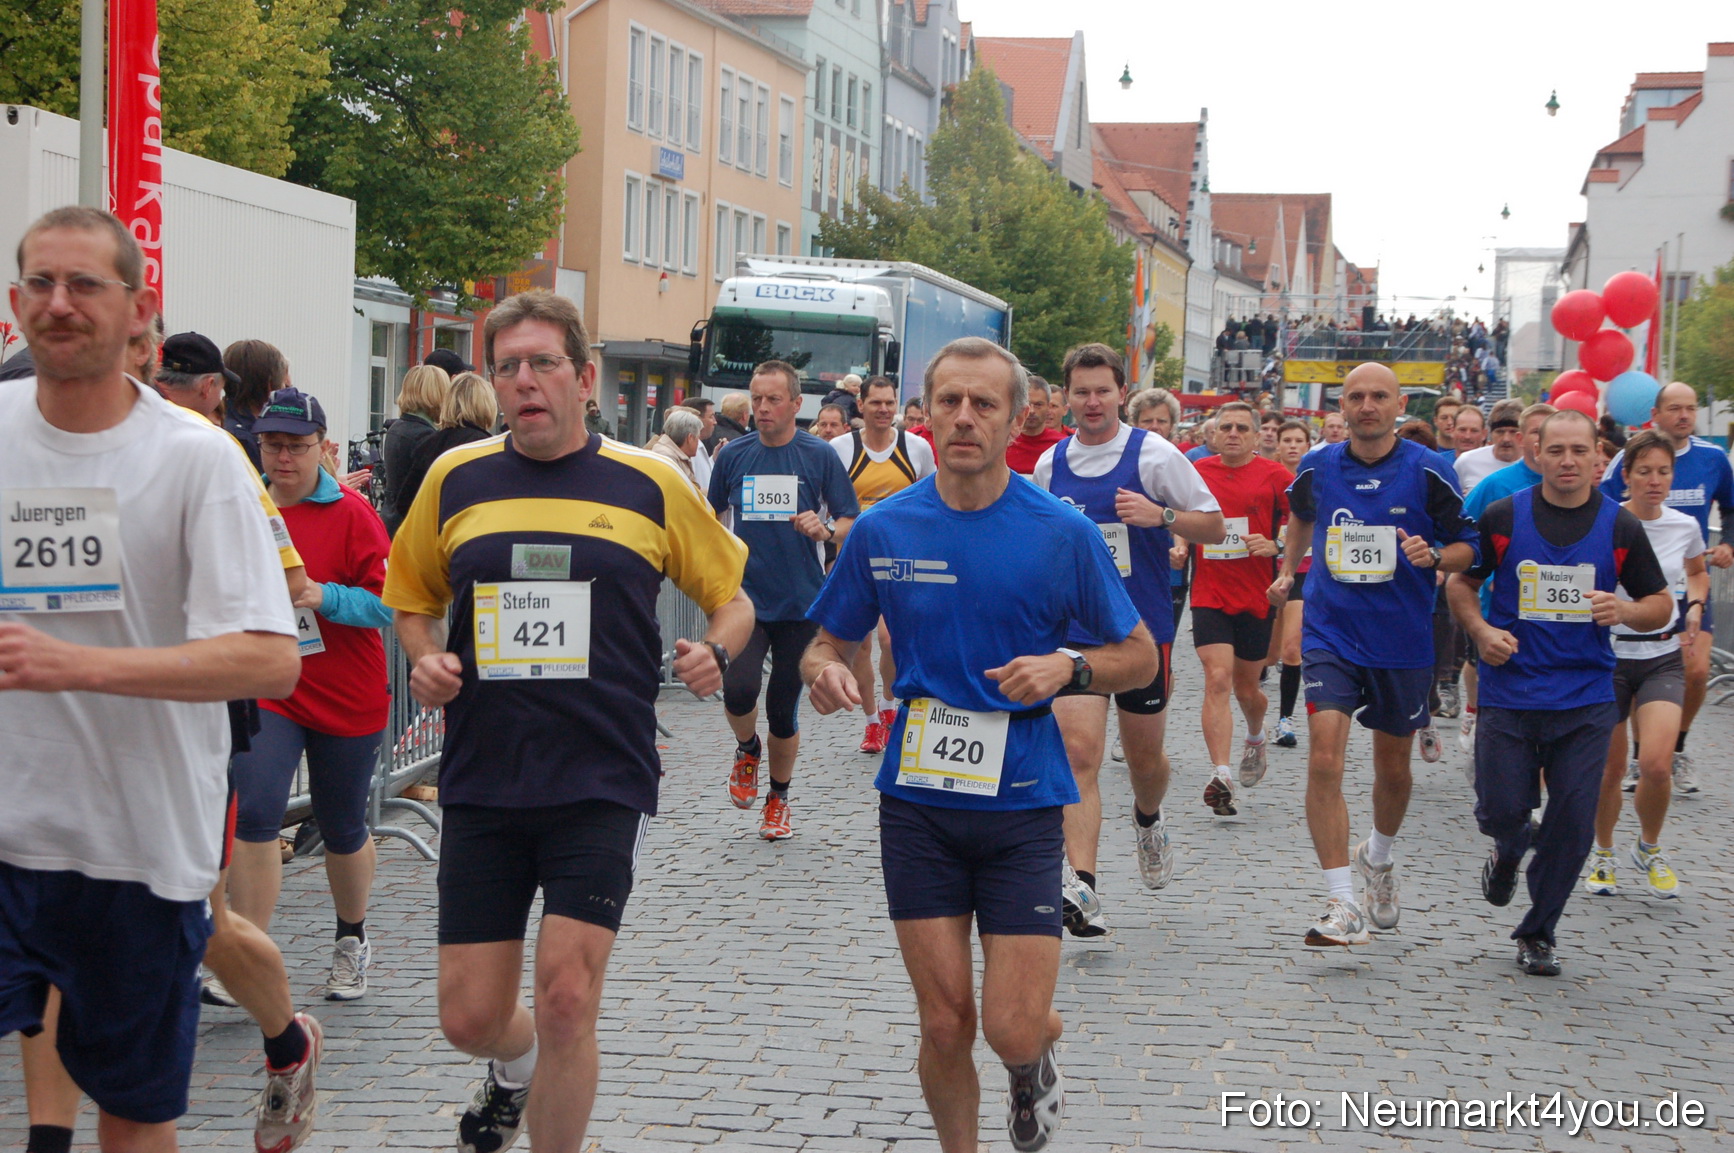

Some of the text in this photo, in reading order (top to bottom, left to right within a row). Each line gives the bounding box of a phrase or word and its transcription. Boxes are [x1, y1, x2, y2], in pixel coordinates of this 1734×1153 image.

[756, 283, 836, 302] BOCK
[757, 493, 790, 505] 3503
[11, 500, 86, 526] Juergen
[588, 522, 614, 530] adidas
[1344, 531, 1375, 542] Helmut
[14, 535, 102, 568] 2619
[1350, 549, 1382, 564] 361
[529, 553, 567, 568] DAV
[1540, 570, 1573, 583] Nikolay
[63, 591, 121, 603] PFLEIDERER
[503, 591, 550, 609] Stefan
[1546, 588, 1580, 604] 363
[479, 621, 486, 634] C
[513, 621, 565, 646] 421
[543, 663, 586, 672] PFLEIDERER
[929, 706, 969, 727] Alfons
[906, 731, 913, 744] B
[932, 736, 984, 765] 420
[955, 778, 997, 791] PFLEIDERER
